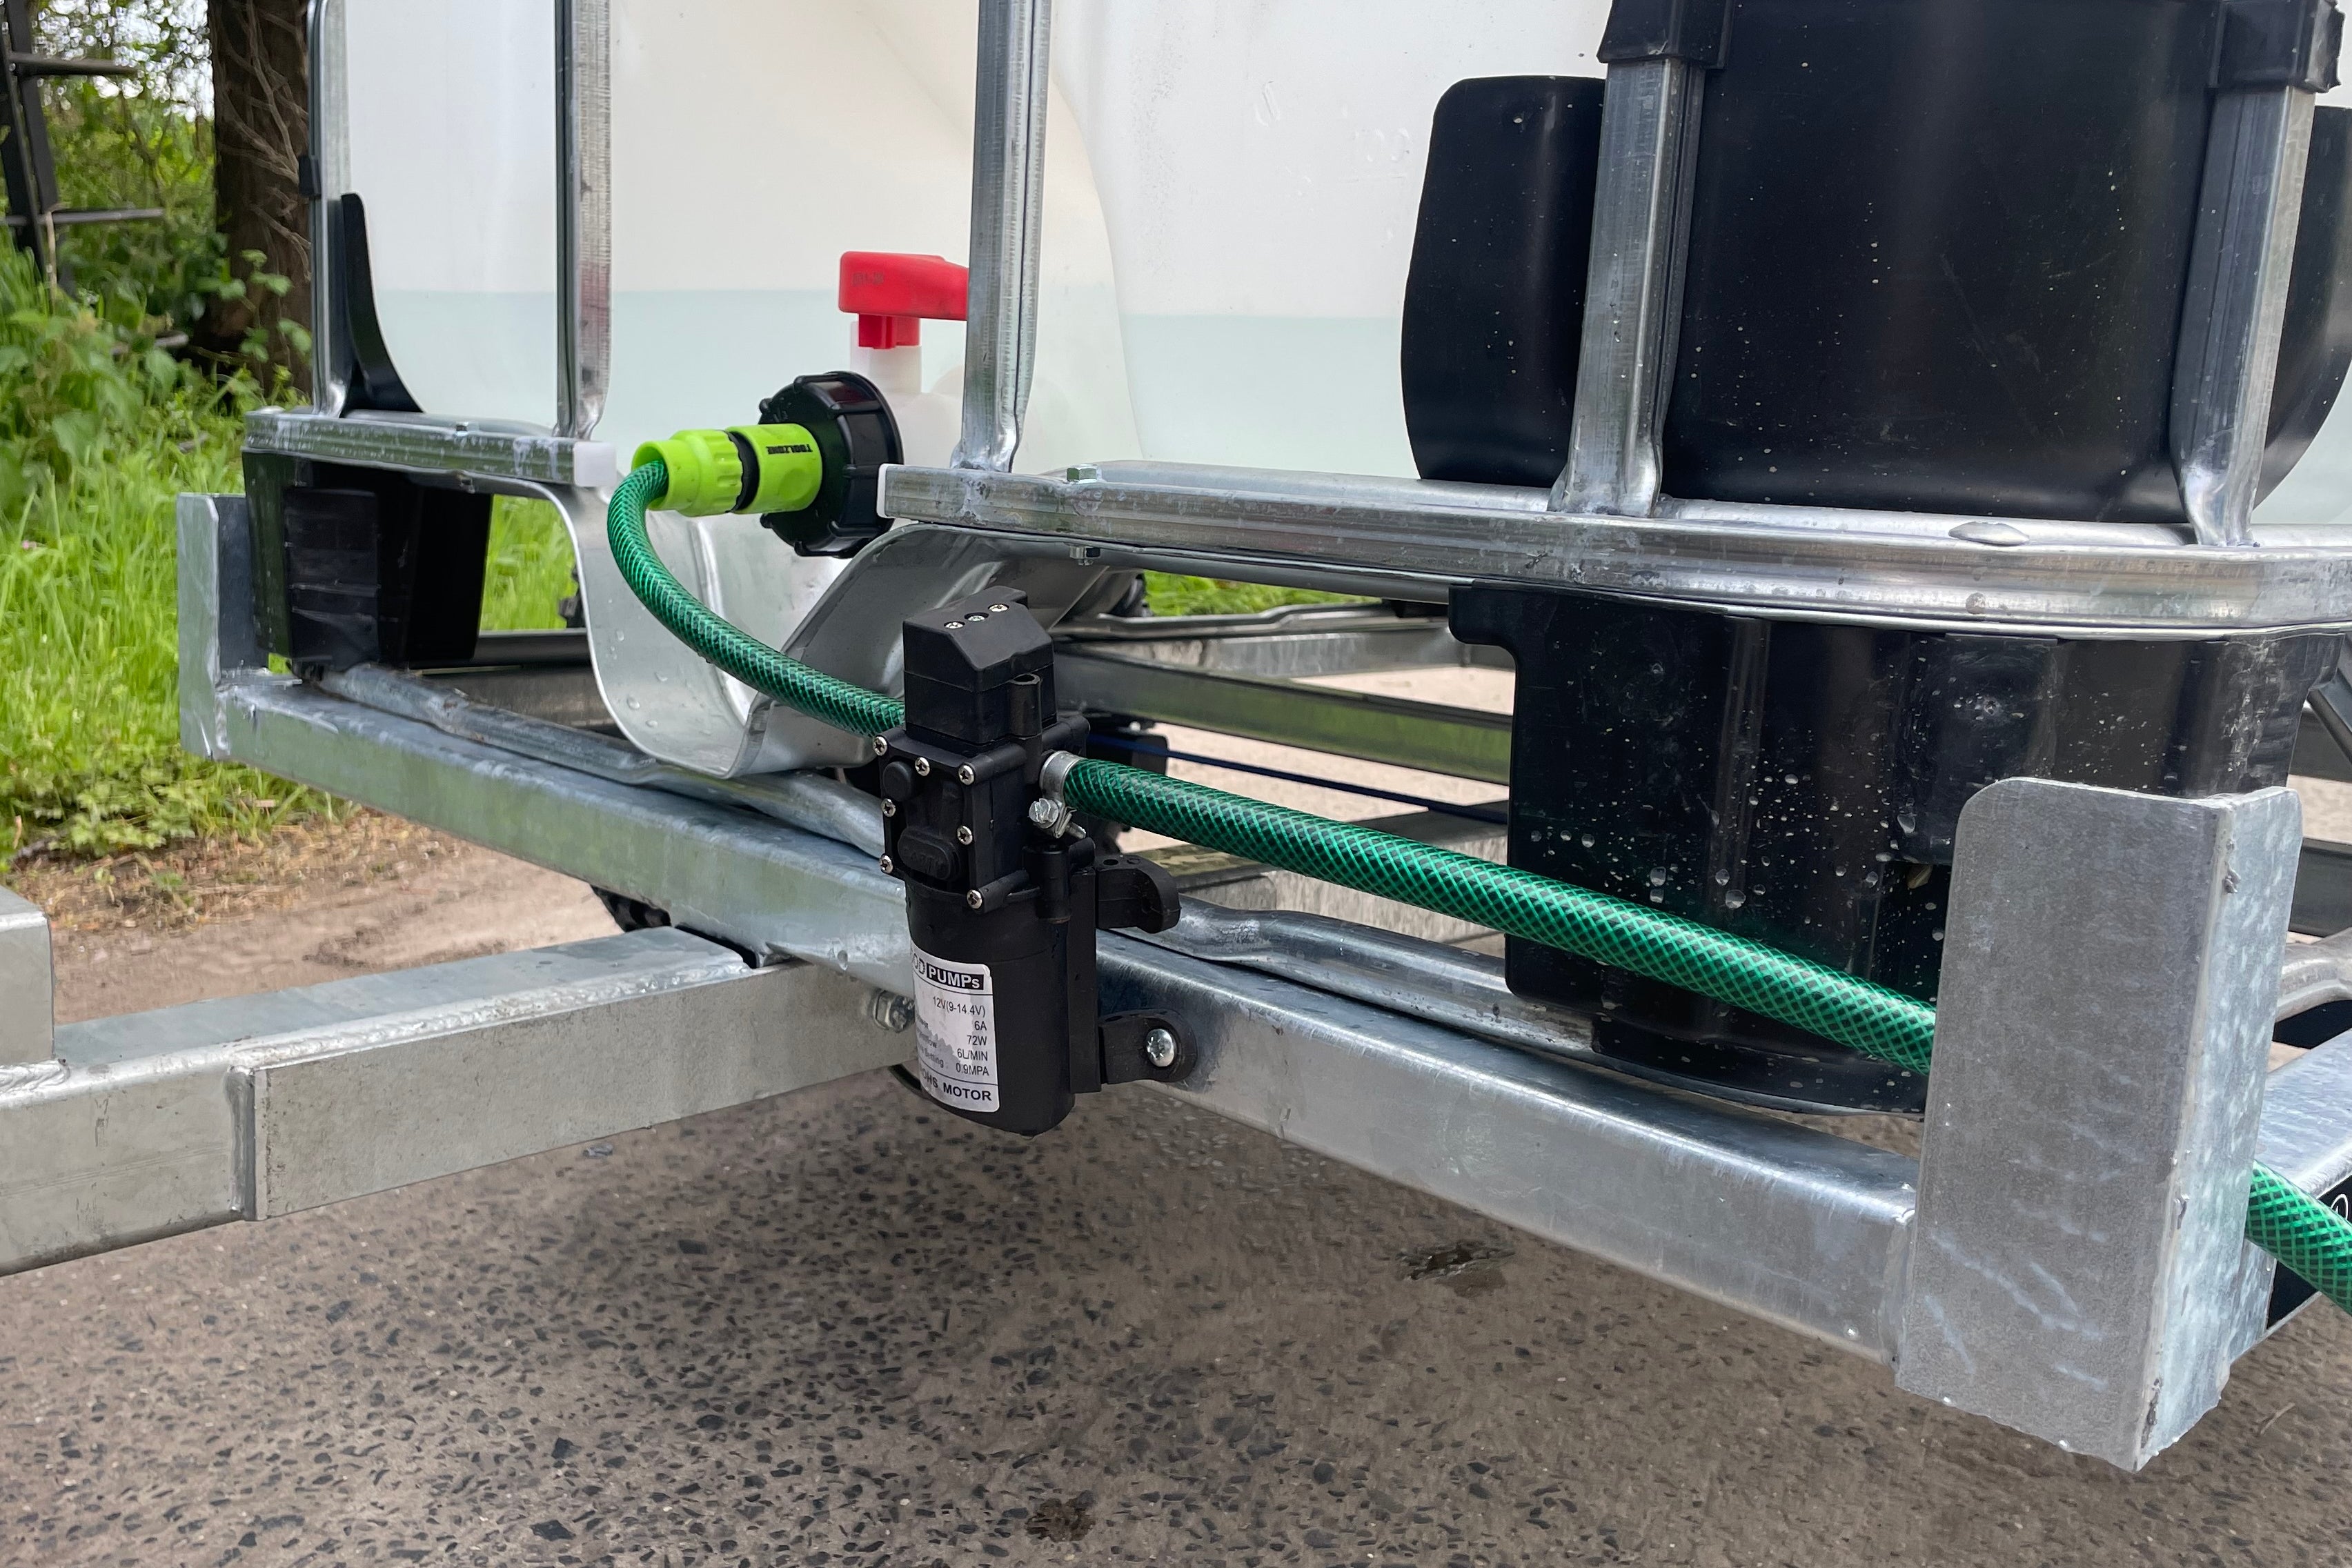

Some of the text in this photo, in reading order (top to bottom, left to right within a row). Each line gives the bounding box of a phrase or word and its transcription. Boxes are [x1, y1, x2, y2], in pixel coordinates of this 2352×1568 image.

[928, 964, 980, 989] PUMPs
[974, 1020, 987, 1031] 6A
[967, 1034, 987, 1046] 72W
[957, 1048, 988, 1061] 6L/MIN
[956, 1062, 989, 1076] 0.9MPA
[942, 1082, 992, 1102] MOTOR
